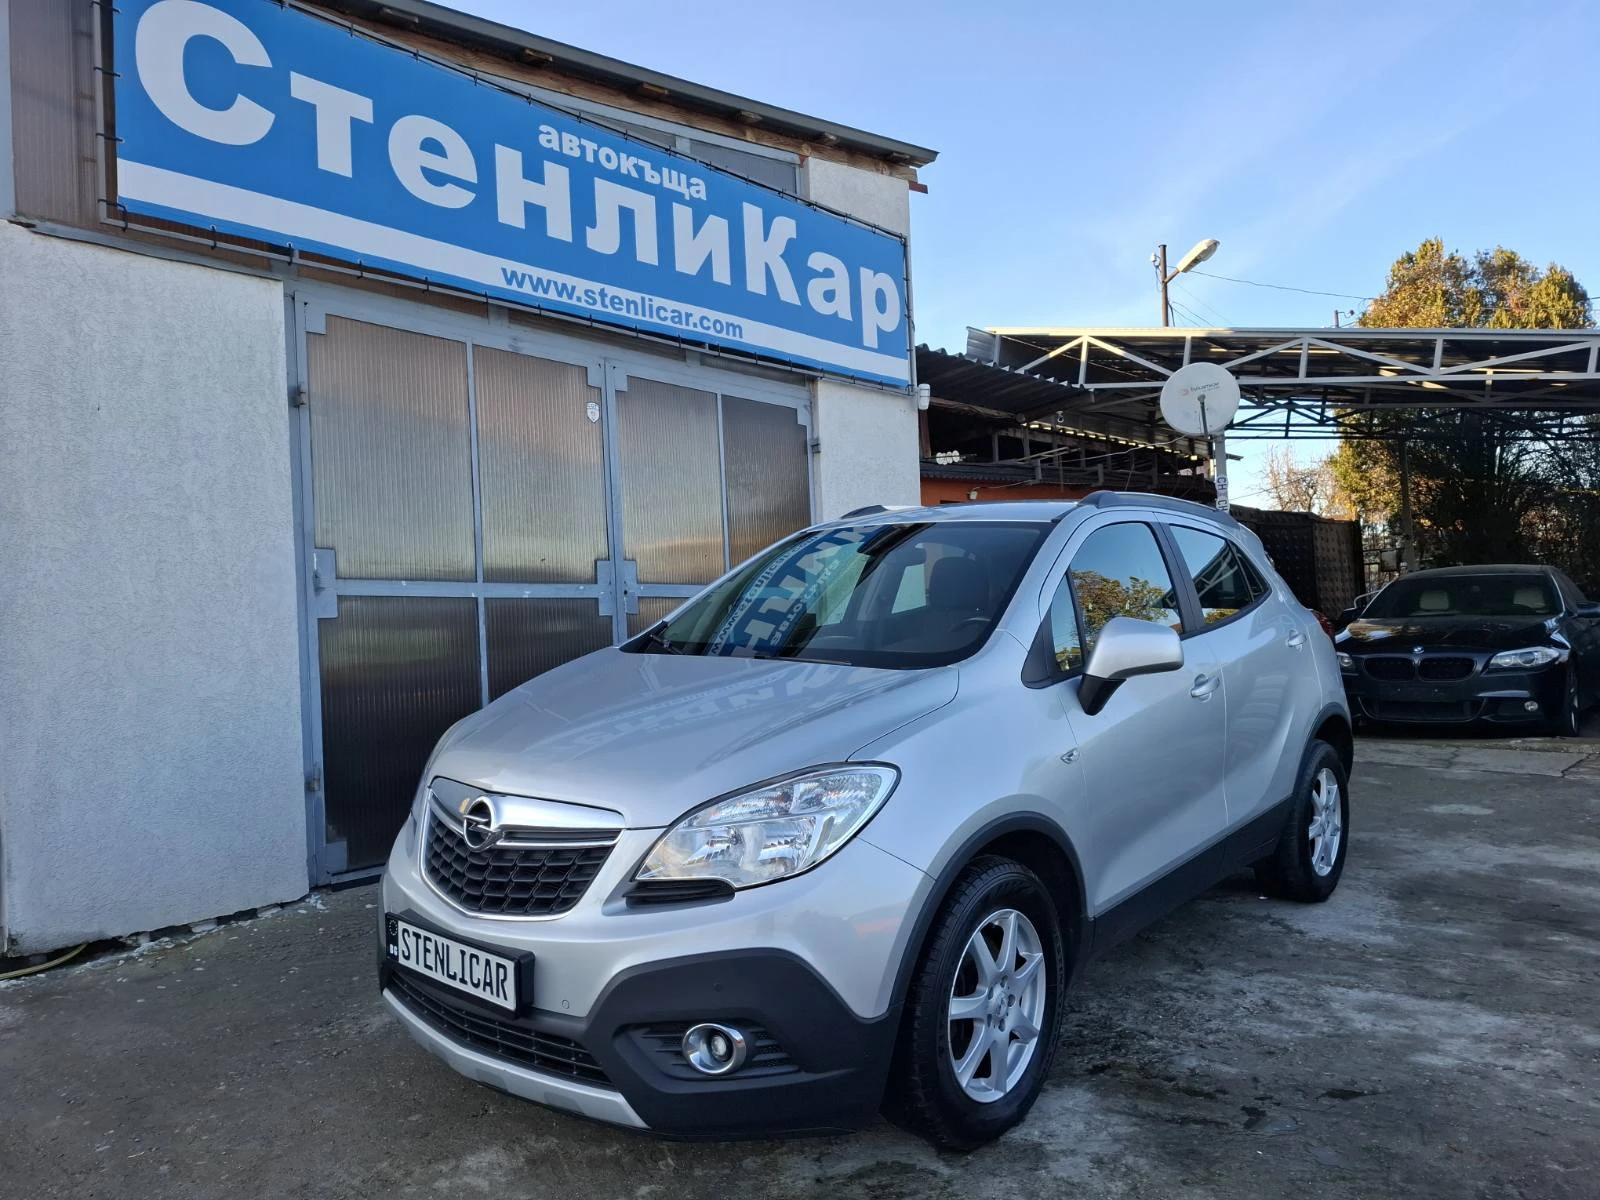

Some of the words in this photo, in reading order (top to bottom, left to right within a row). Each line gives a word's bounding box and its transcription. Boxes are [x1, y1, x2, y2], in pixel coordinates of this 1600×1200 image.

[135, 0, 901, 348] СтенлиКар
[538, 124, 707, 200] автокъща
[501, 266, 744, 339] www.stenlicar.com
[389, 943, 398, 956] BG
[401, 927, 508, 1001] STENLICAR
